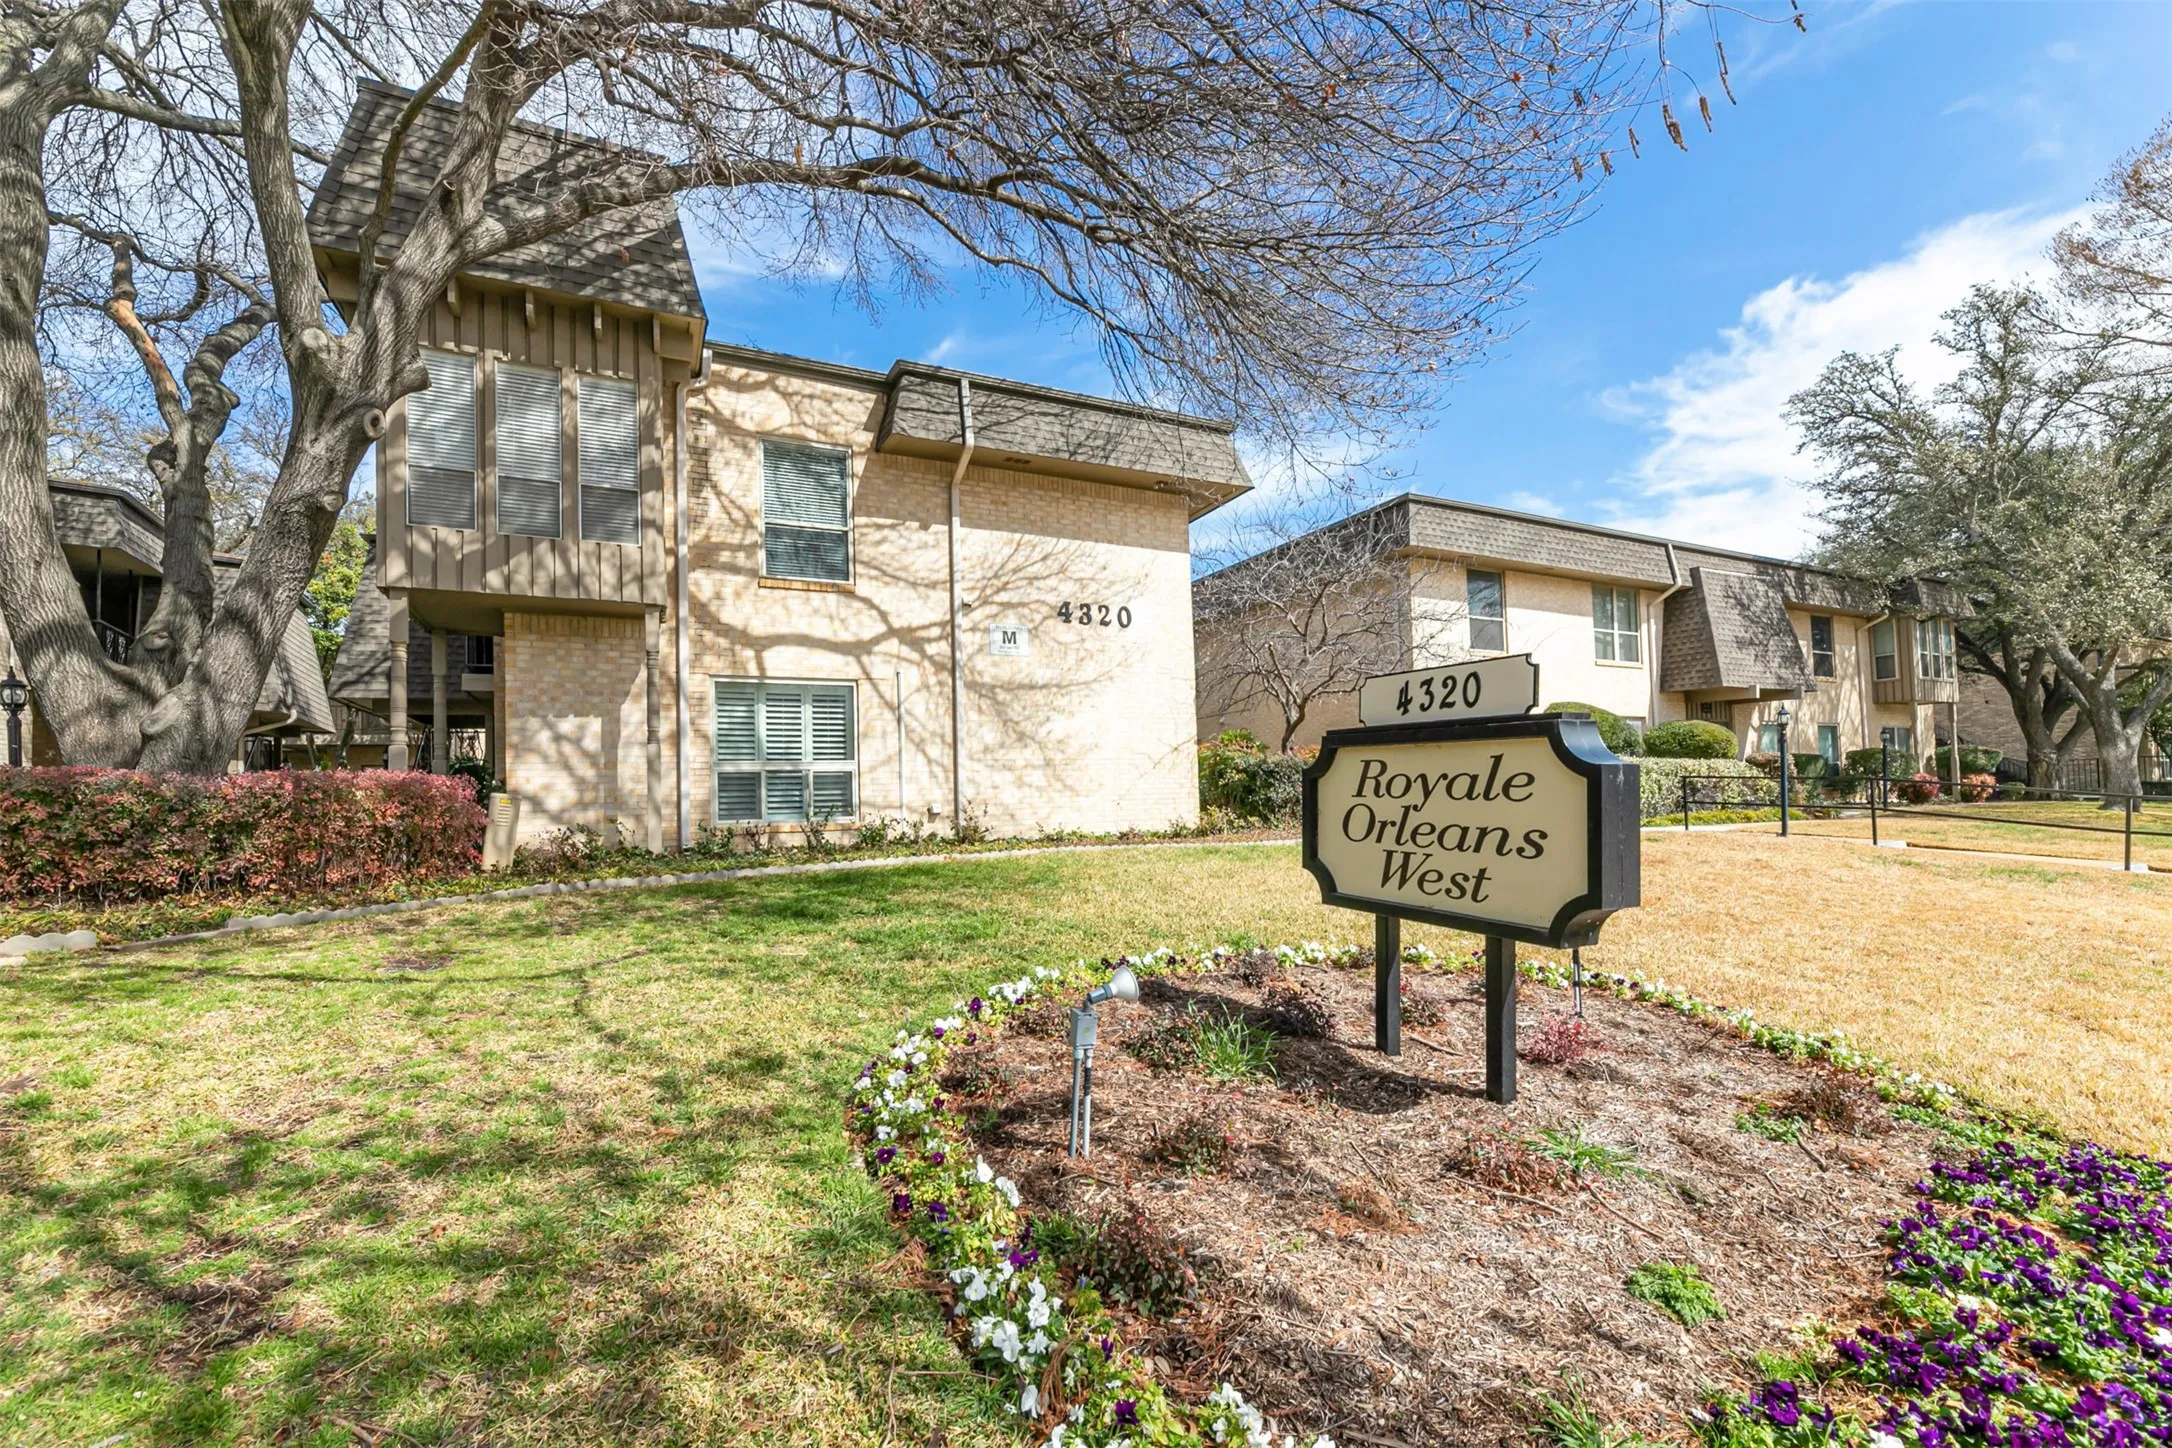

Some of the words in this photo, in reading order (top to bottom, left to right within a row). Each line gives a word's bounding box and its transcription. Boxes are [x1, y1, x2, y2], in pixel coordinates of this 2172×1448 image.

[1002, 630, 1017, 645] M
[1057, 601, 1132, 629] 4320
[1396, 671, 1482, 716] 4320
[1351, 753, 1536, 812] Royale
[1342, 803, 1549, 859] Orleans
[1380, 849, 1492, 903] West
